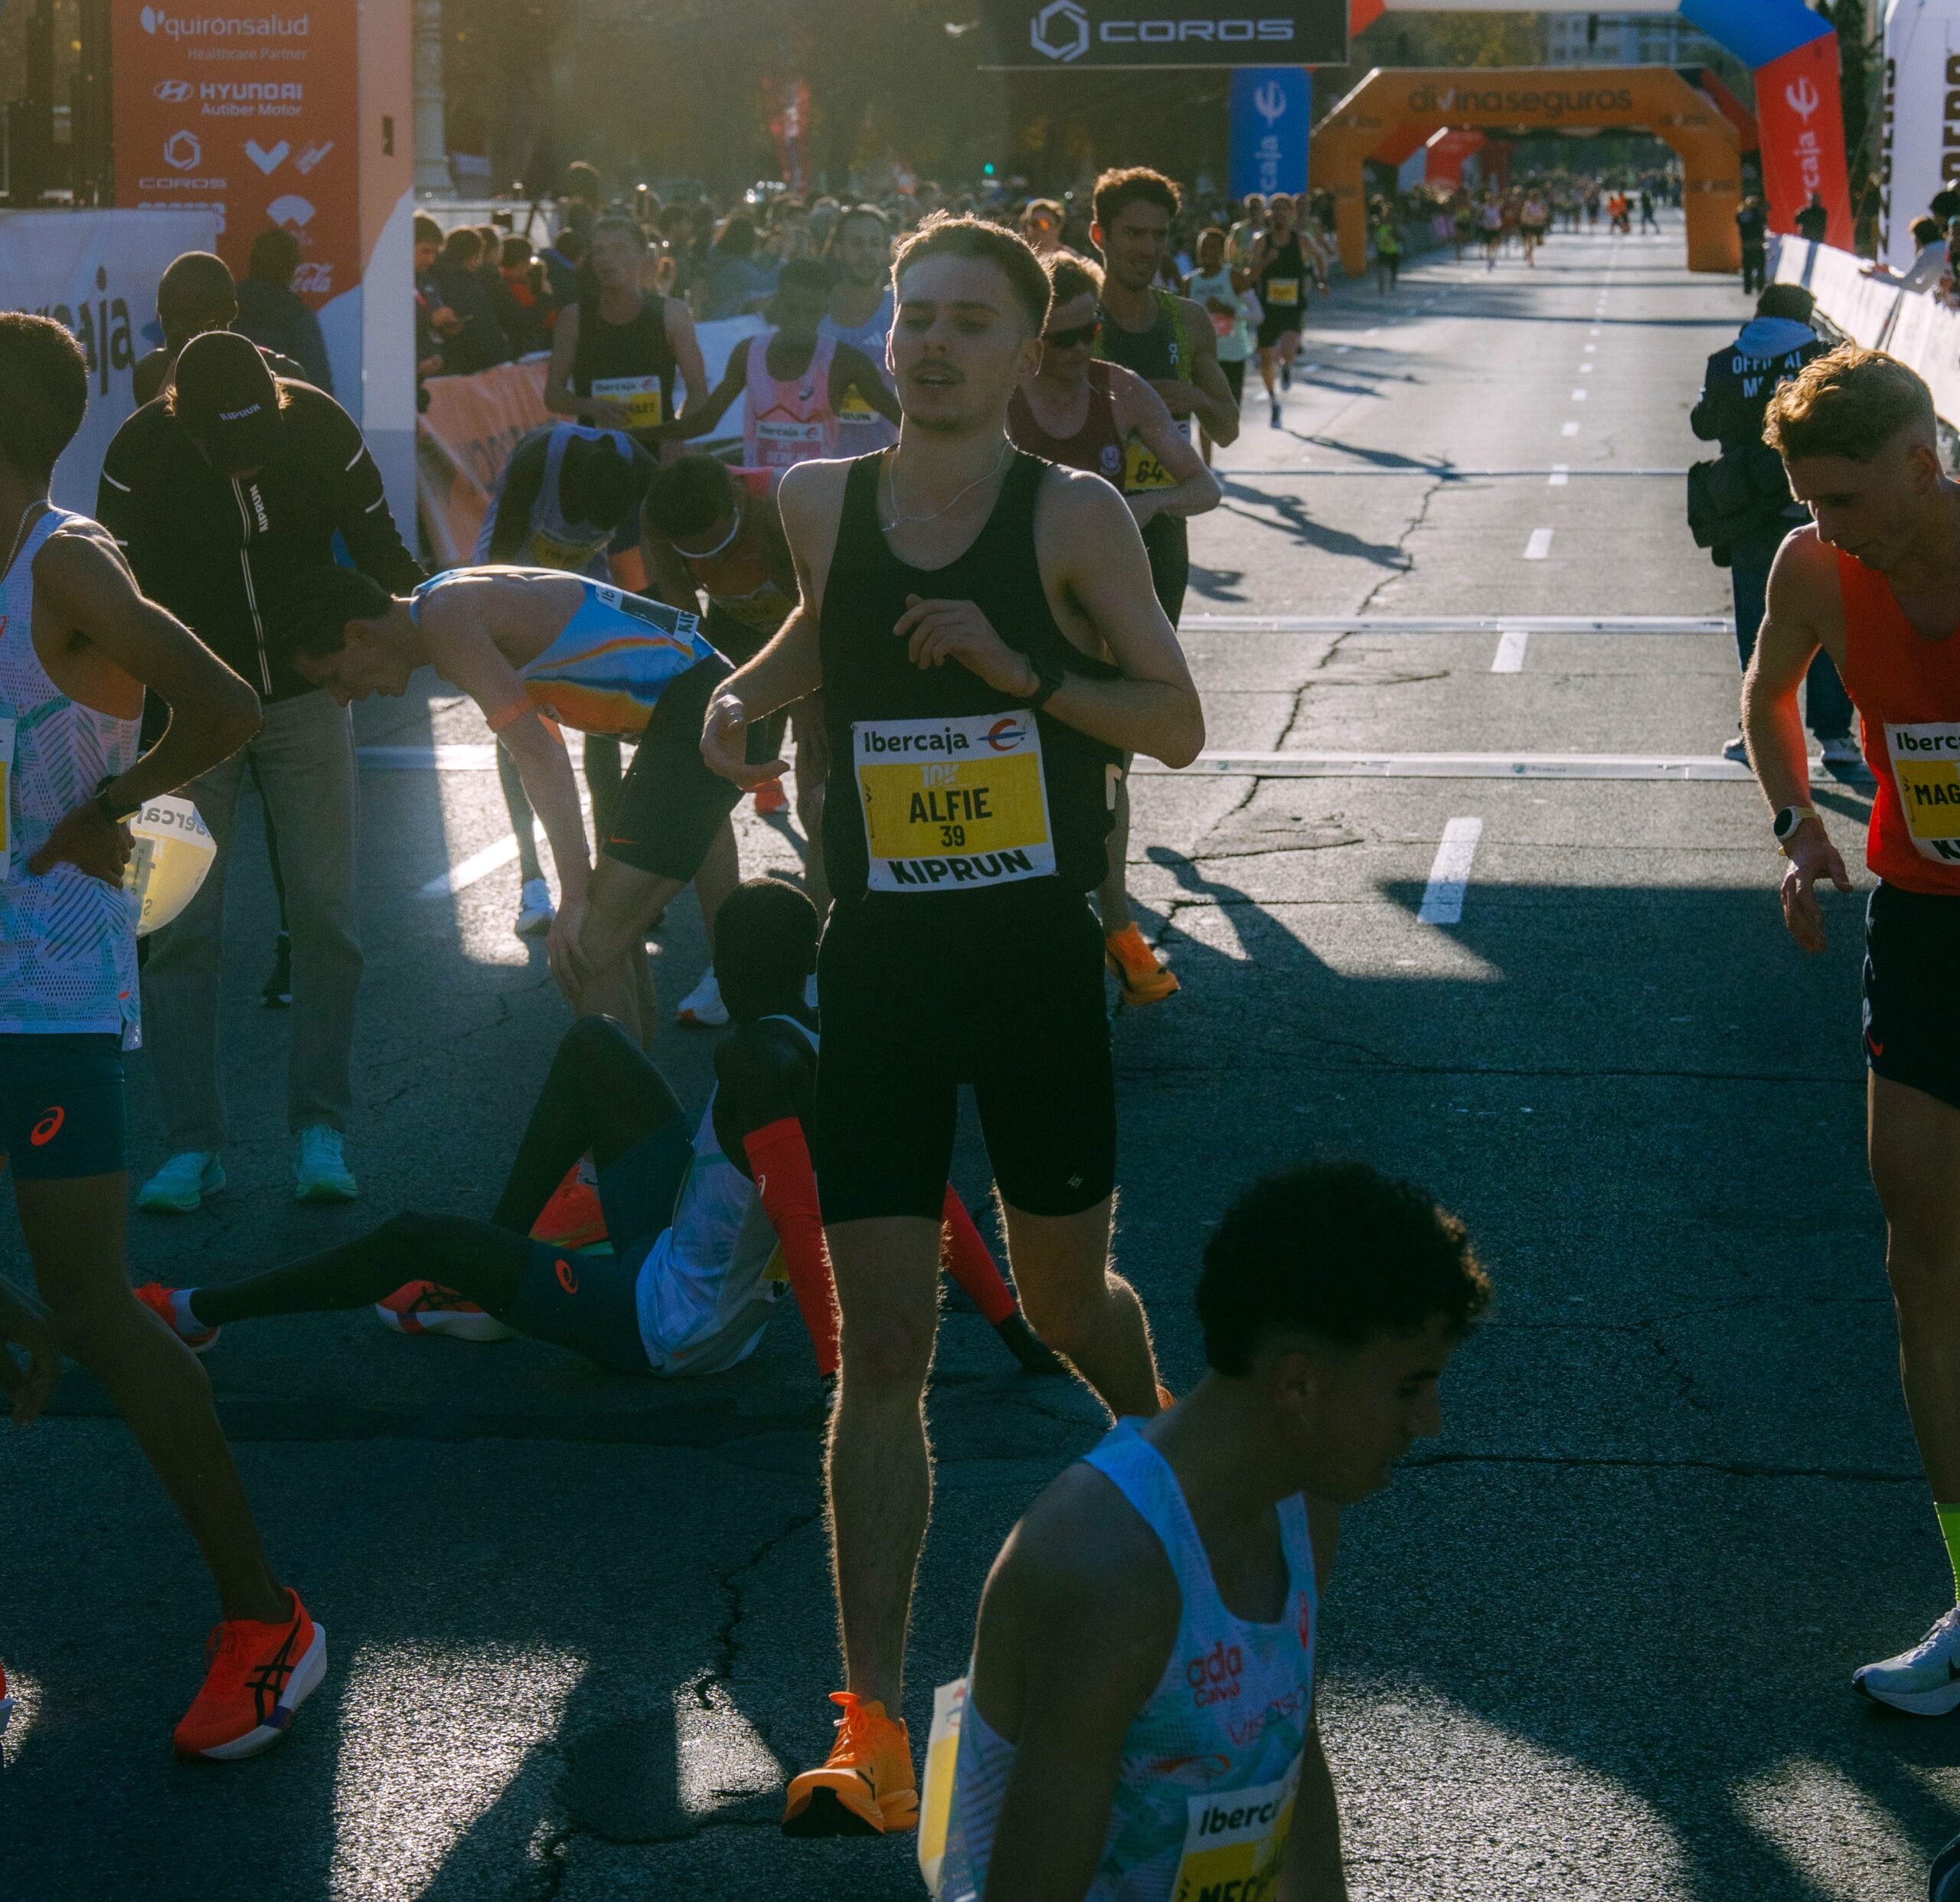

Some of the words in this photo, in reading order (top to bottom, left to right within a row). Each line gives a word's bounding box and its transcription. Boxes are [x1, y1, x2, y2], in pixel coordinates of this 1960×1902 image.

[1099, 19, 1294, 41] COROS
[188, 47, 257, 60] Healthcare
[200, 83, 303, 100] HYUNDAI
[257, 103, 302, 116] Motor
[139, 178, 227, 189] COROS
[220, 404, 261, 420] KIPRUN
[250, 484, 269, 533] KIPRUN
[864, 727, 969, 755] Ibercaja
[1896, 733, 1960, 751] Iberc
[910, 787, 992, 824] ALFIE
[940, 825, 965, 847] 39
[887, 849, 1034, 884] KIPRUN
